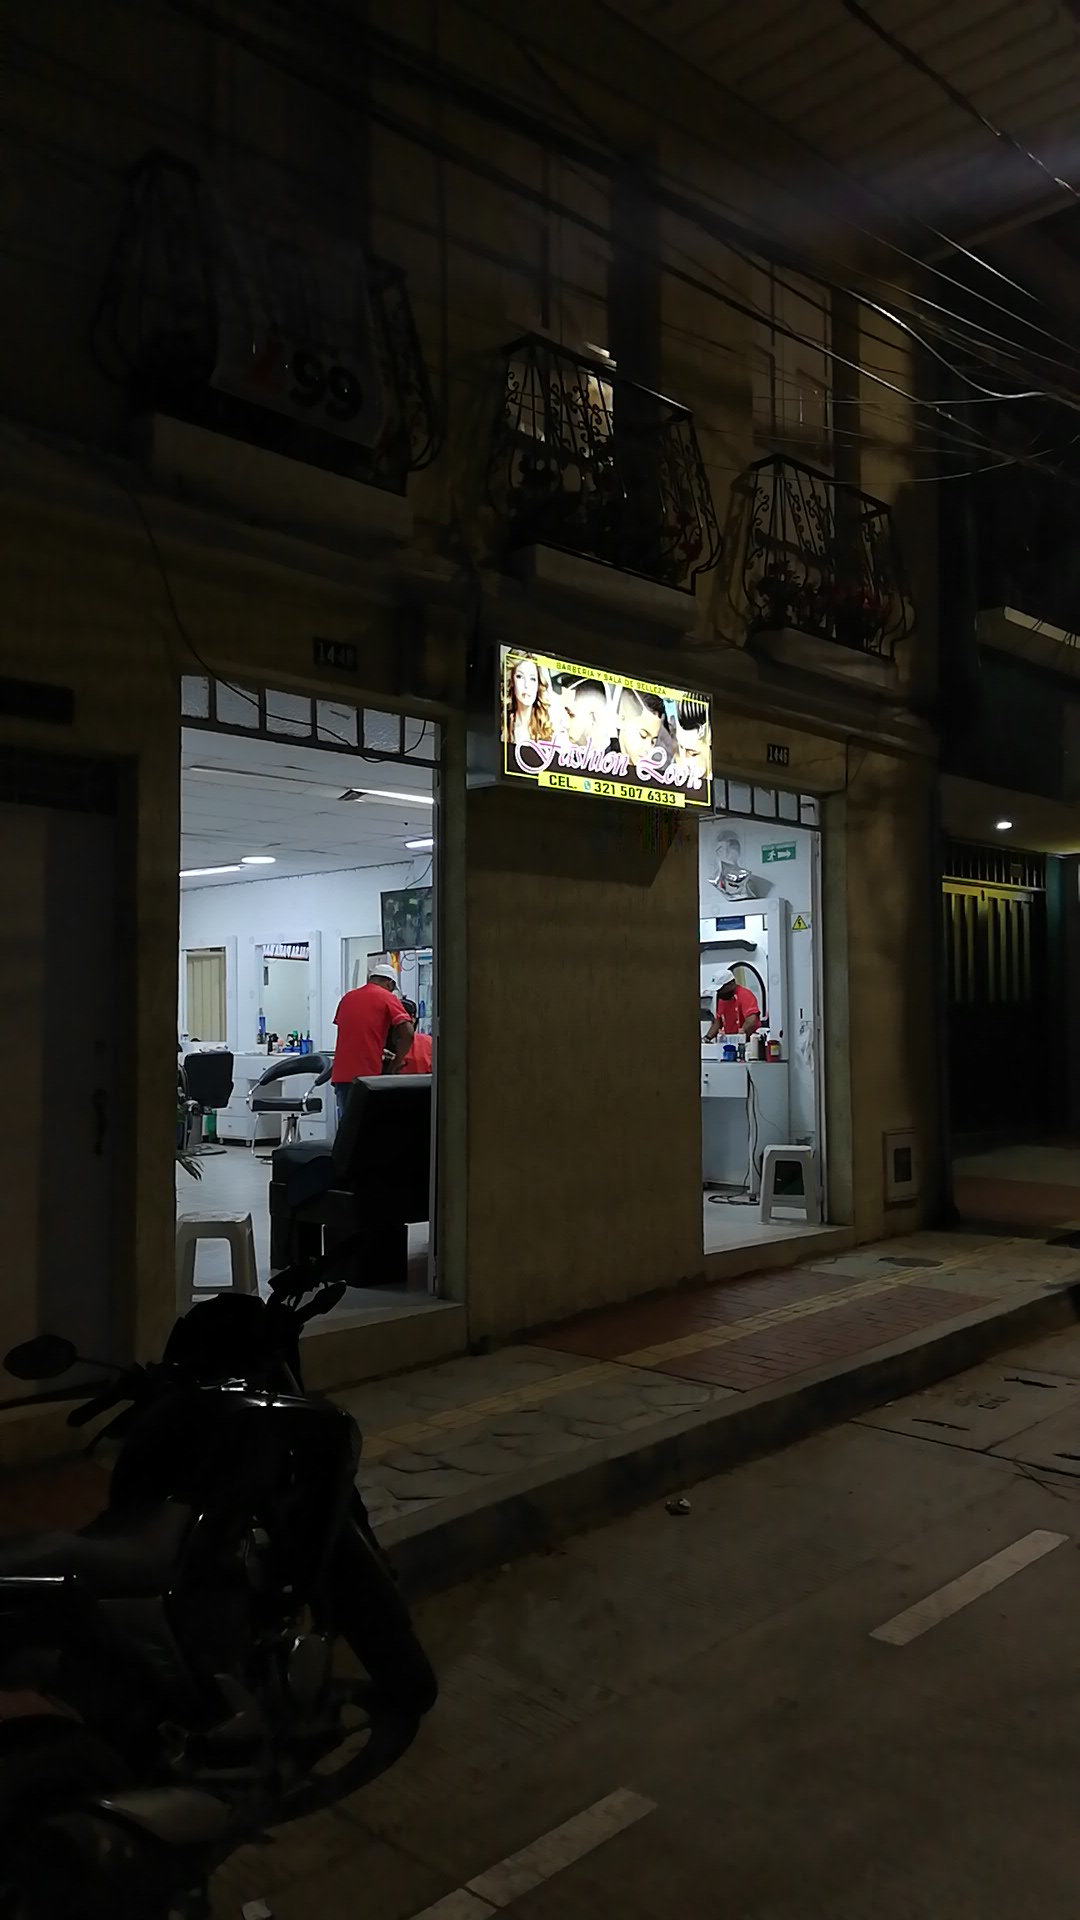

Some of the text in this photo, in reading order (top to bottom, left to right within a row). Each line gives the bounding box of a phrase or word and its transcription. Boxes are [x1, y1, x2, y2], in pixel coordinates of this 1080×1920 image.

[556, 661, 595, 678] BARBERIA
[603, 673, 622, 685] SALA
[624, 678, 634, 688] DE
[514, 735, 629, 776] Fashion
[549, 774, 676, 804] CEL. 321 507 6333
